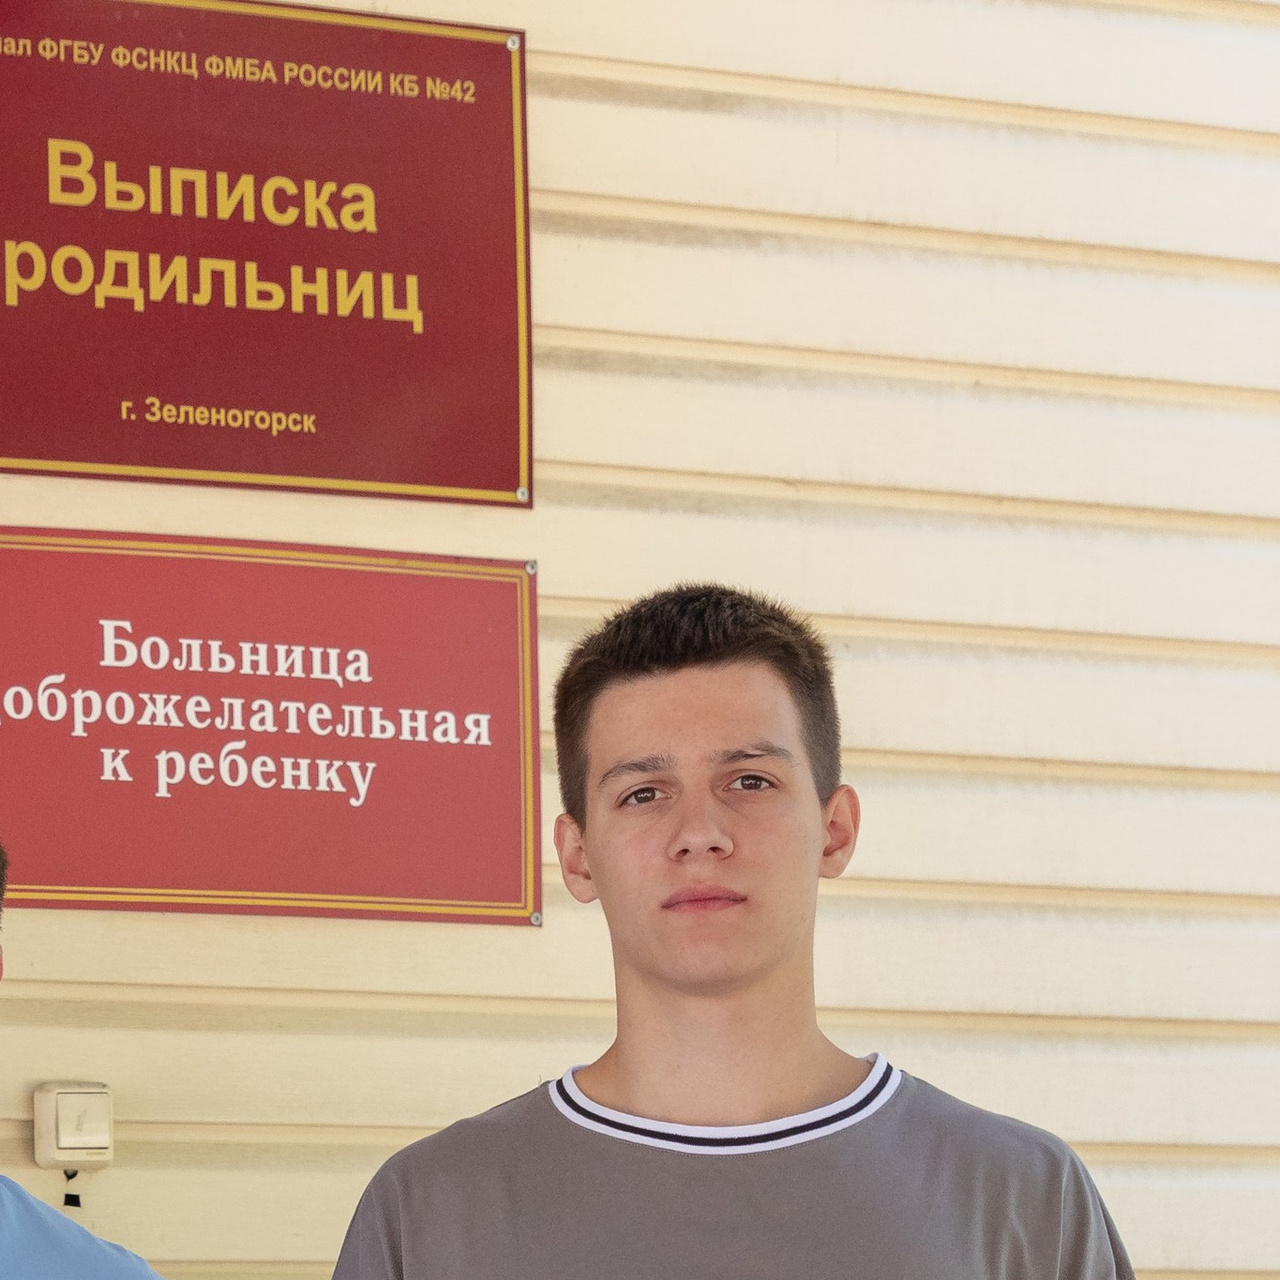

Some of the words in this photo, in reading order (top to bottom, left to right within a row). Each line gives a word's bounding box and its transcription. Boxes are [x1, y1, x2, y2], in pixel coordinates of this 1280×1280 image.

[38, 37, 104, 66] ФГБУ
[111, 45, 199, 80] ФСНКЦ
[204, 54, 278, 84] ФМБА
[283, 61, 383, 95] РОССИИ
[389, 73, 419, 99] КБ
[426, 76, 476, 104] №42
[46, 138, 378, 233] Выписка
[4, 239, 423, 333] родильниц
[120, 401, 136, 420] г.
[144, 397, 317, 436] Зеленогорск
[98, 619, 373, 688] Больница
[100, 747, 133, 782] к
[155, 741, 376, 807] ребенку
